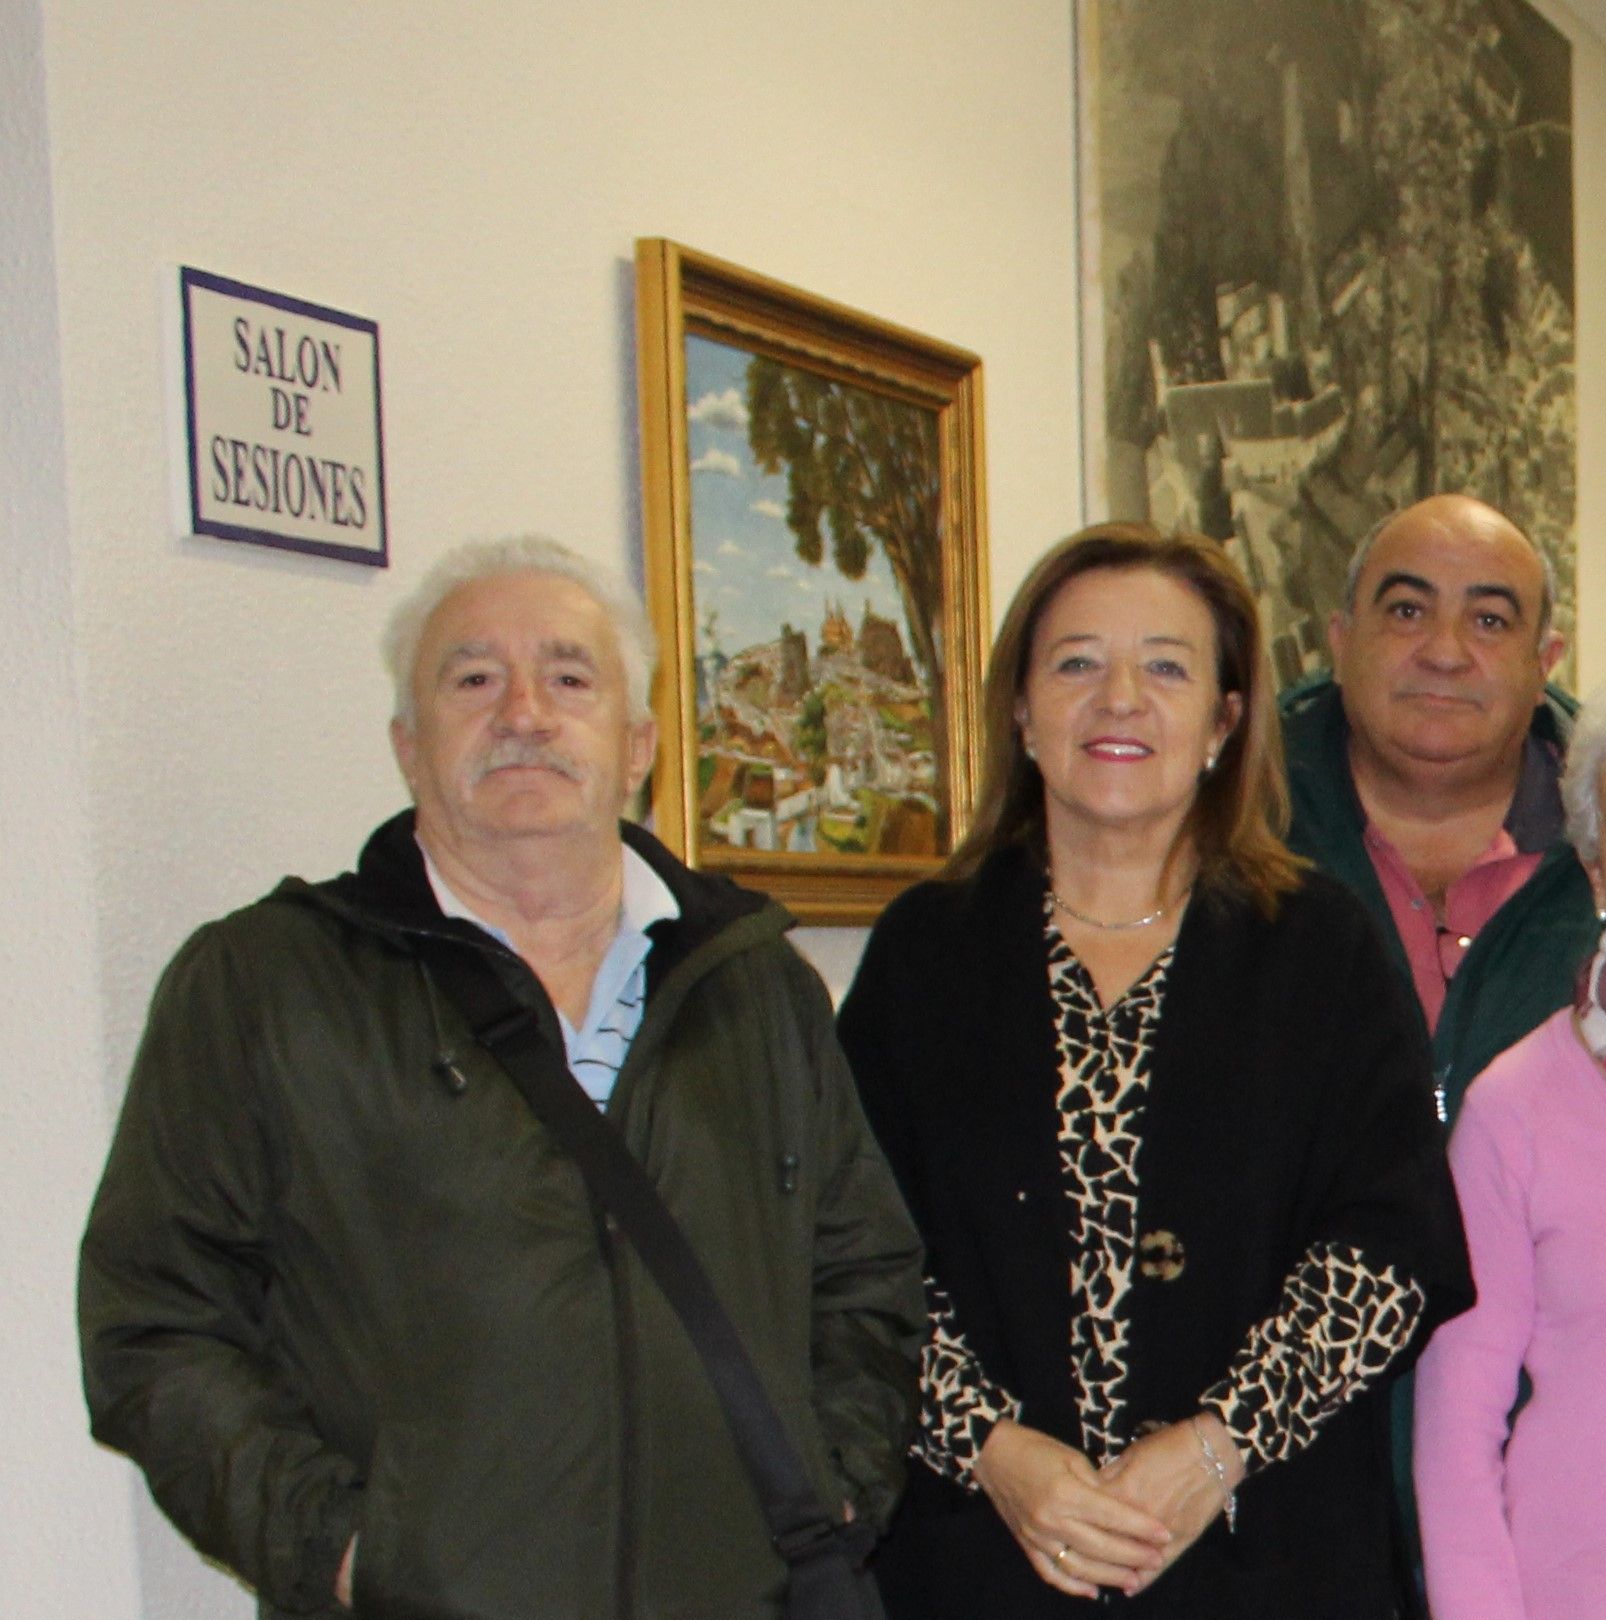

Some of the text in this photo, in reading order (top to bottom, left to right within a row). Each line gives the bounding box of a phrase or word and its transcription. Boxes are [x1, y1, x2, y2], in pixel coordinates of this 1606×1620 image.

[233, 316, 342, 394] SALON
[270, 387, 312, 436] DE
[210, 434, 367, 530] SESIONES
